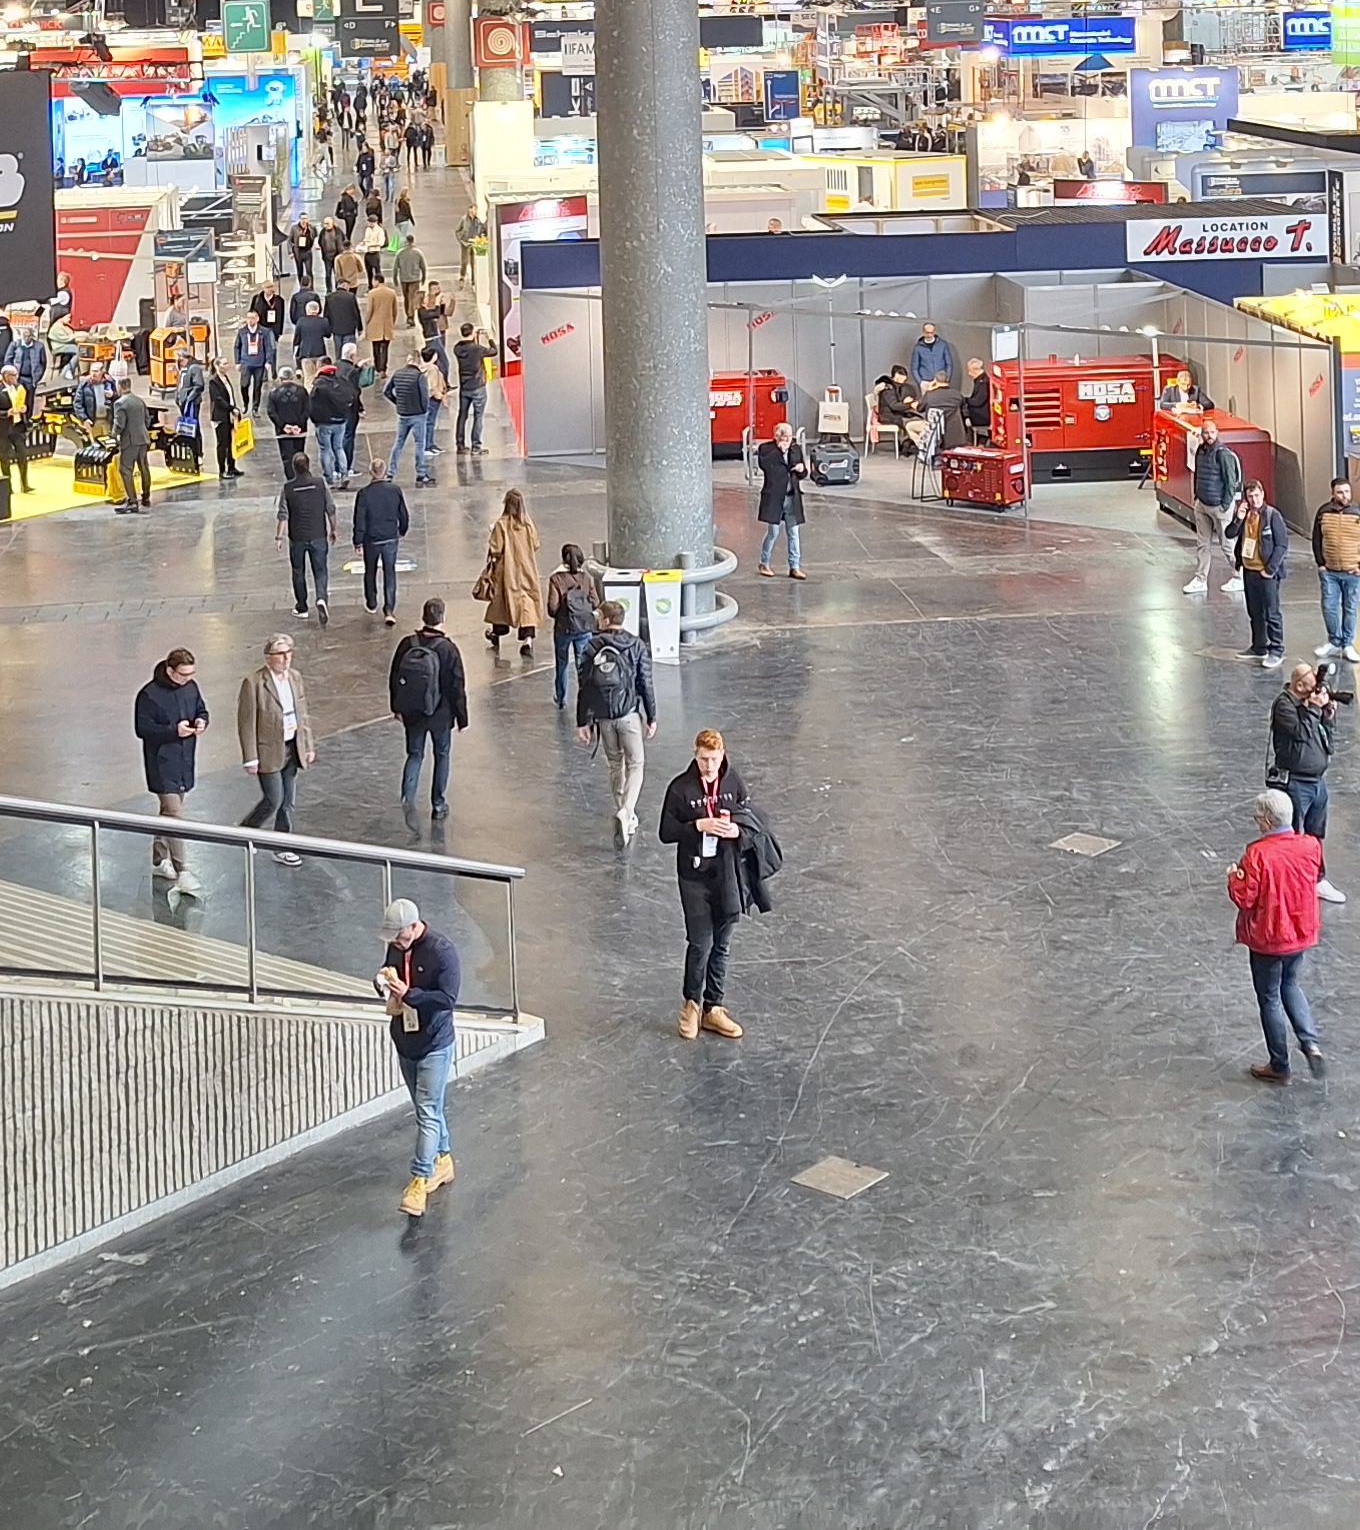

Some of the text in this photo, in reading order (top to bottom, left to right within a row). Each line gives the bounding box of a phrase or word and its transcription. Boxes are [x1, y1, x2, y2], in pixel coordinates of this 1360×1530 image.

[968, 4, 975, 12] G
[349, 22, 356, 30] D
[1202, 222, 1269, 233] LOCATION
[1143, 224, 1278, 256] Massucco
[540, 322, 577, 346] MOSA
[1078, 382, 1135, 396] MOSA
